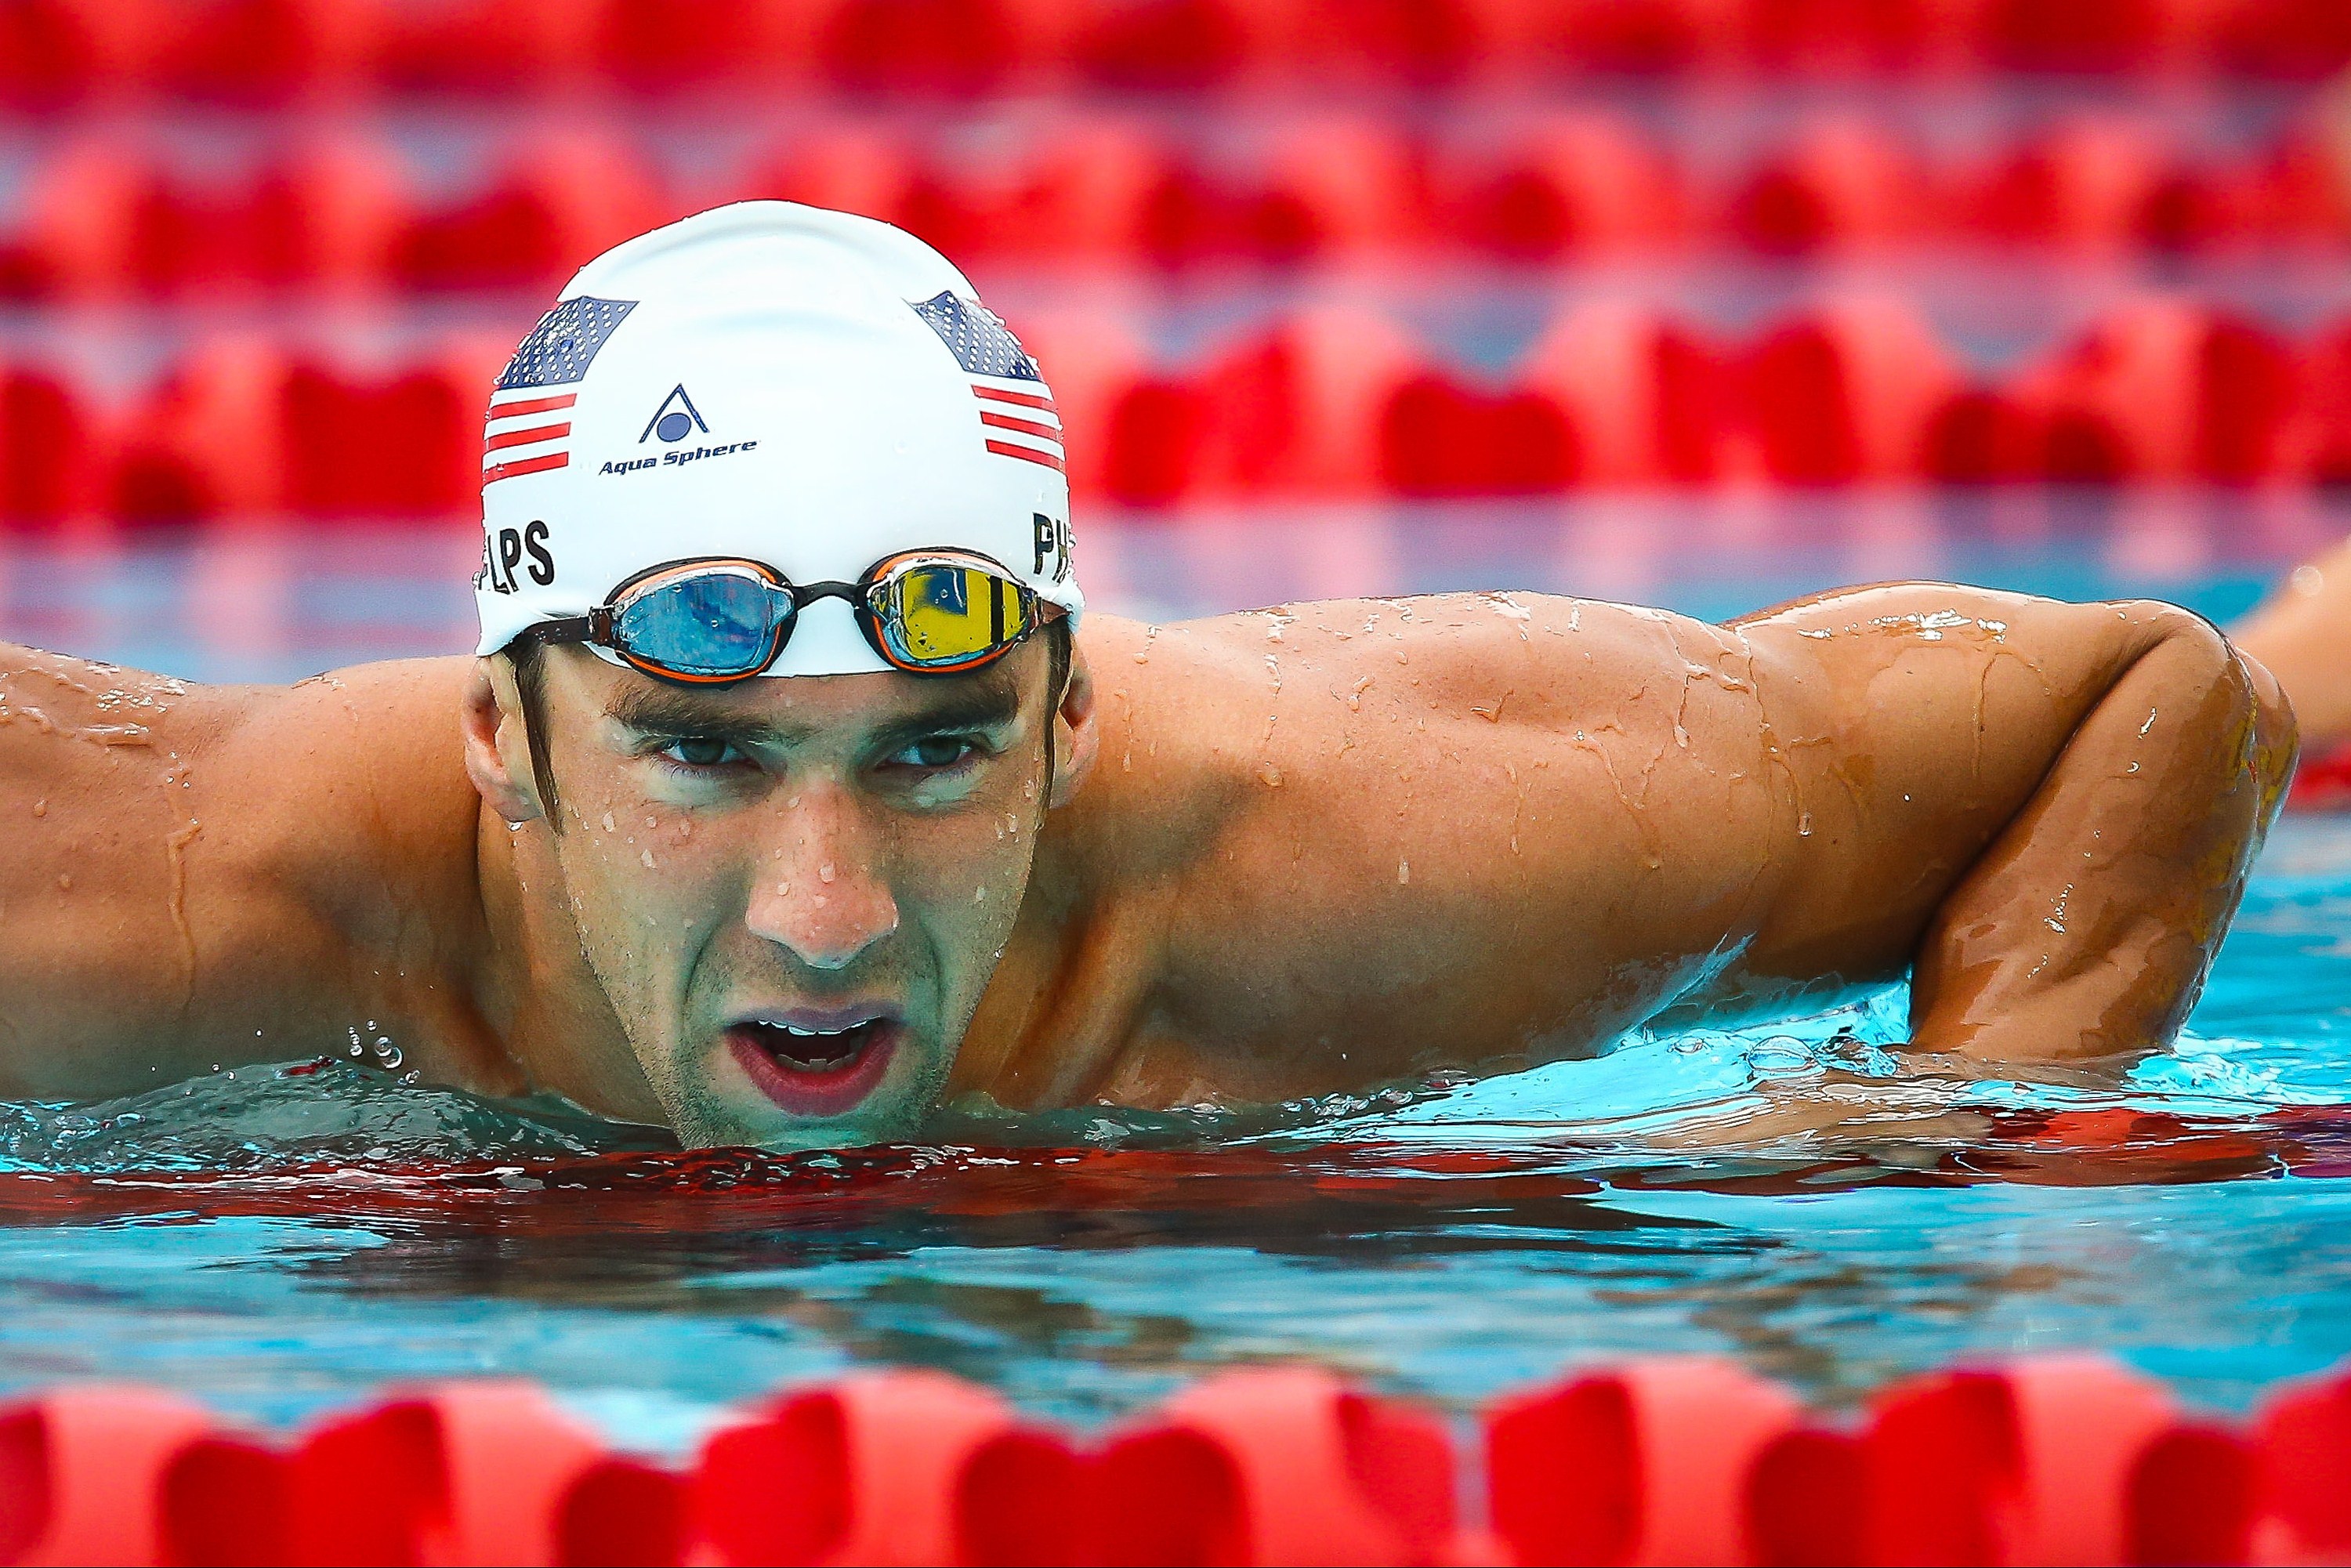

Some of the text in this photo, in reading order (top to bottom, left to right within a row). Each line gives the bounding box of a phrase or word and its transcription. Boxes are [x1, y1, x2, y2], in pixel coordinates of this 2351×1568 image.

[599, 440, 757, 476] Aqua Sphere
[477, 520, 555, 595] LPS
